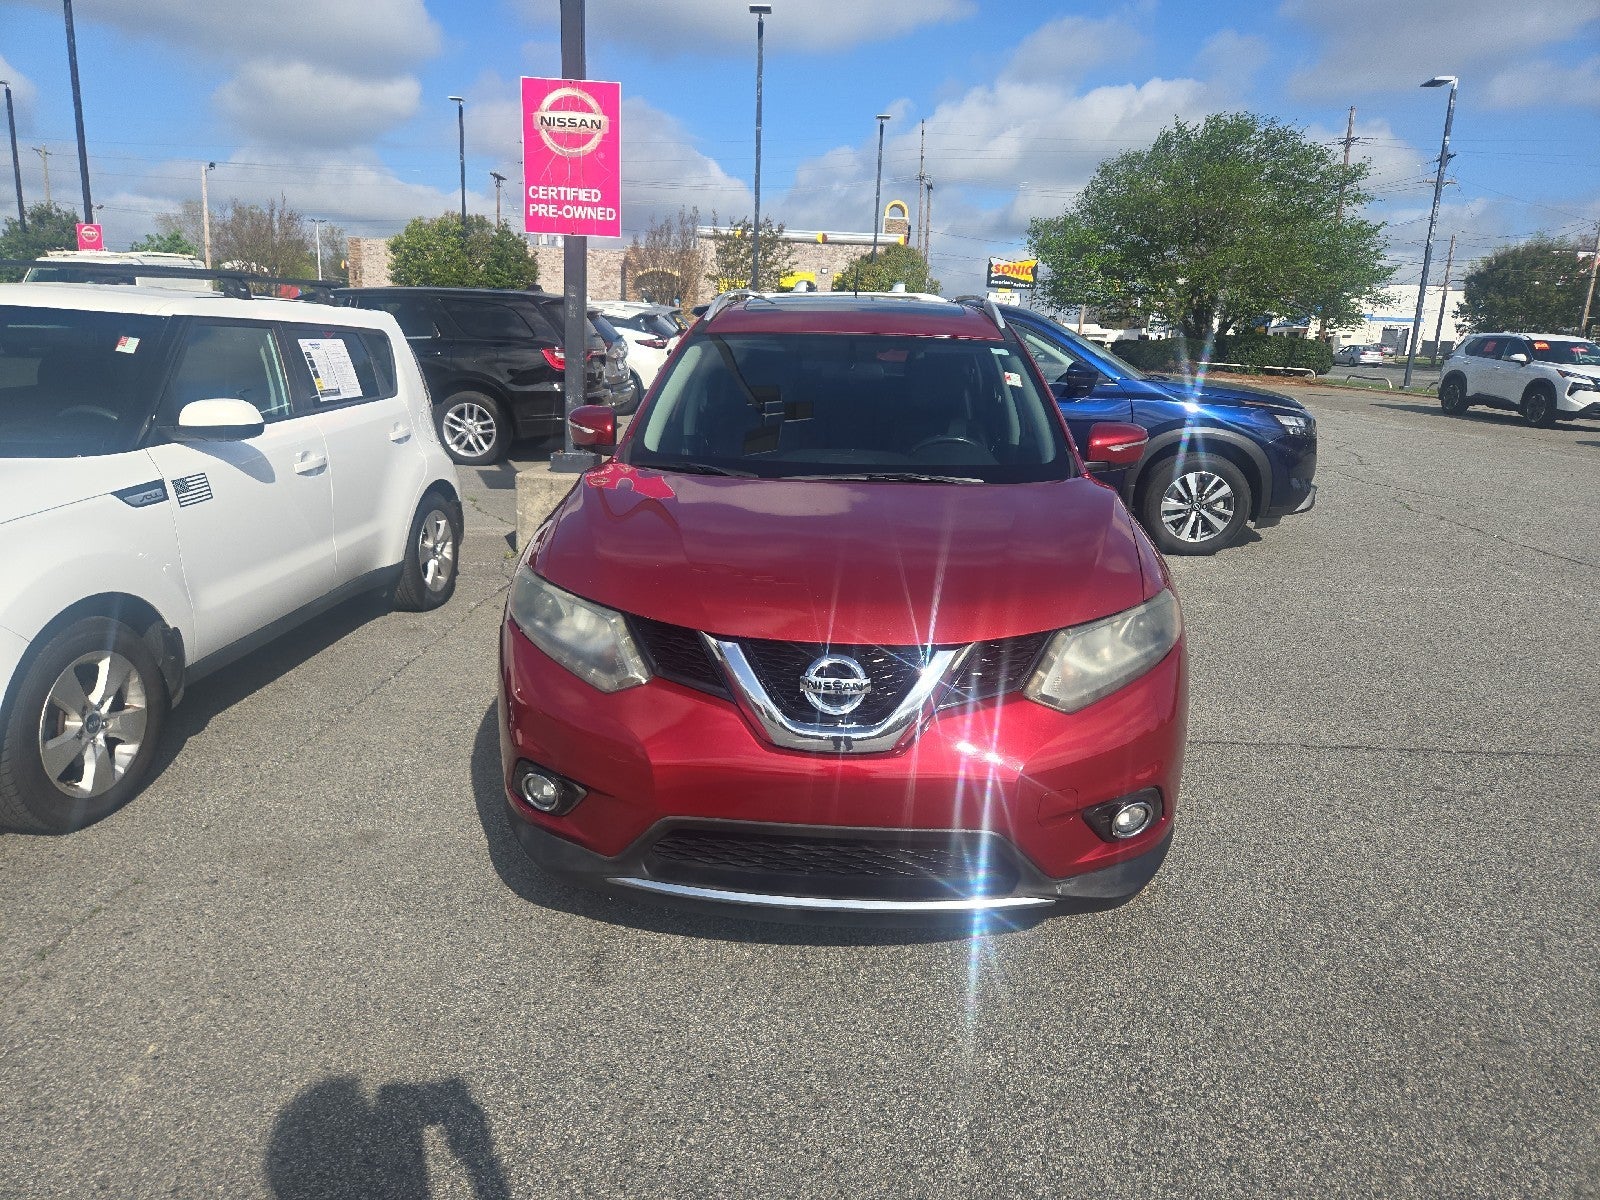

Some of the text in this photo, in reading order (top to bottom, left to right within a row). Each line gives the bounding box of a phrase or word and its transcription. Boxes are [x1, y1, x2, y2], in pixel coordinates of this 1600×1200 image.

[540, 115, 602, 130] NISSAN
[528, 186, 602, 203] CERTIFIED
[529, 204, 616, 221] PRE-OWNED
[993, 263, 1033, 276] SONIC
[807, 680, 864, 691] NISSAN
